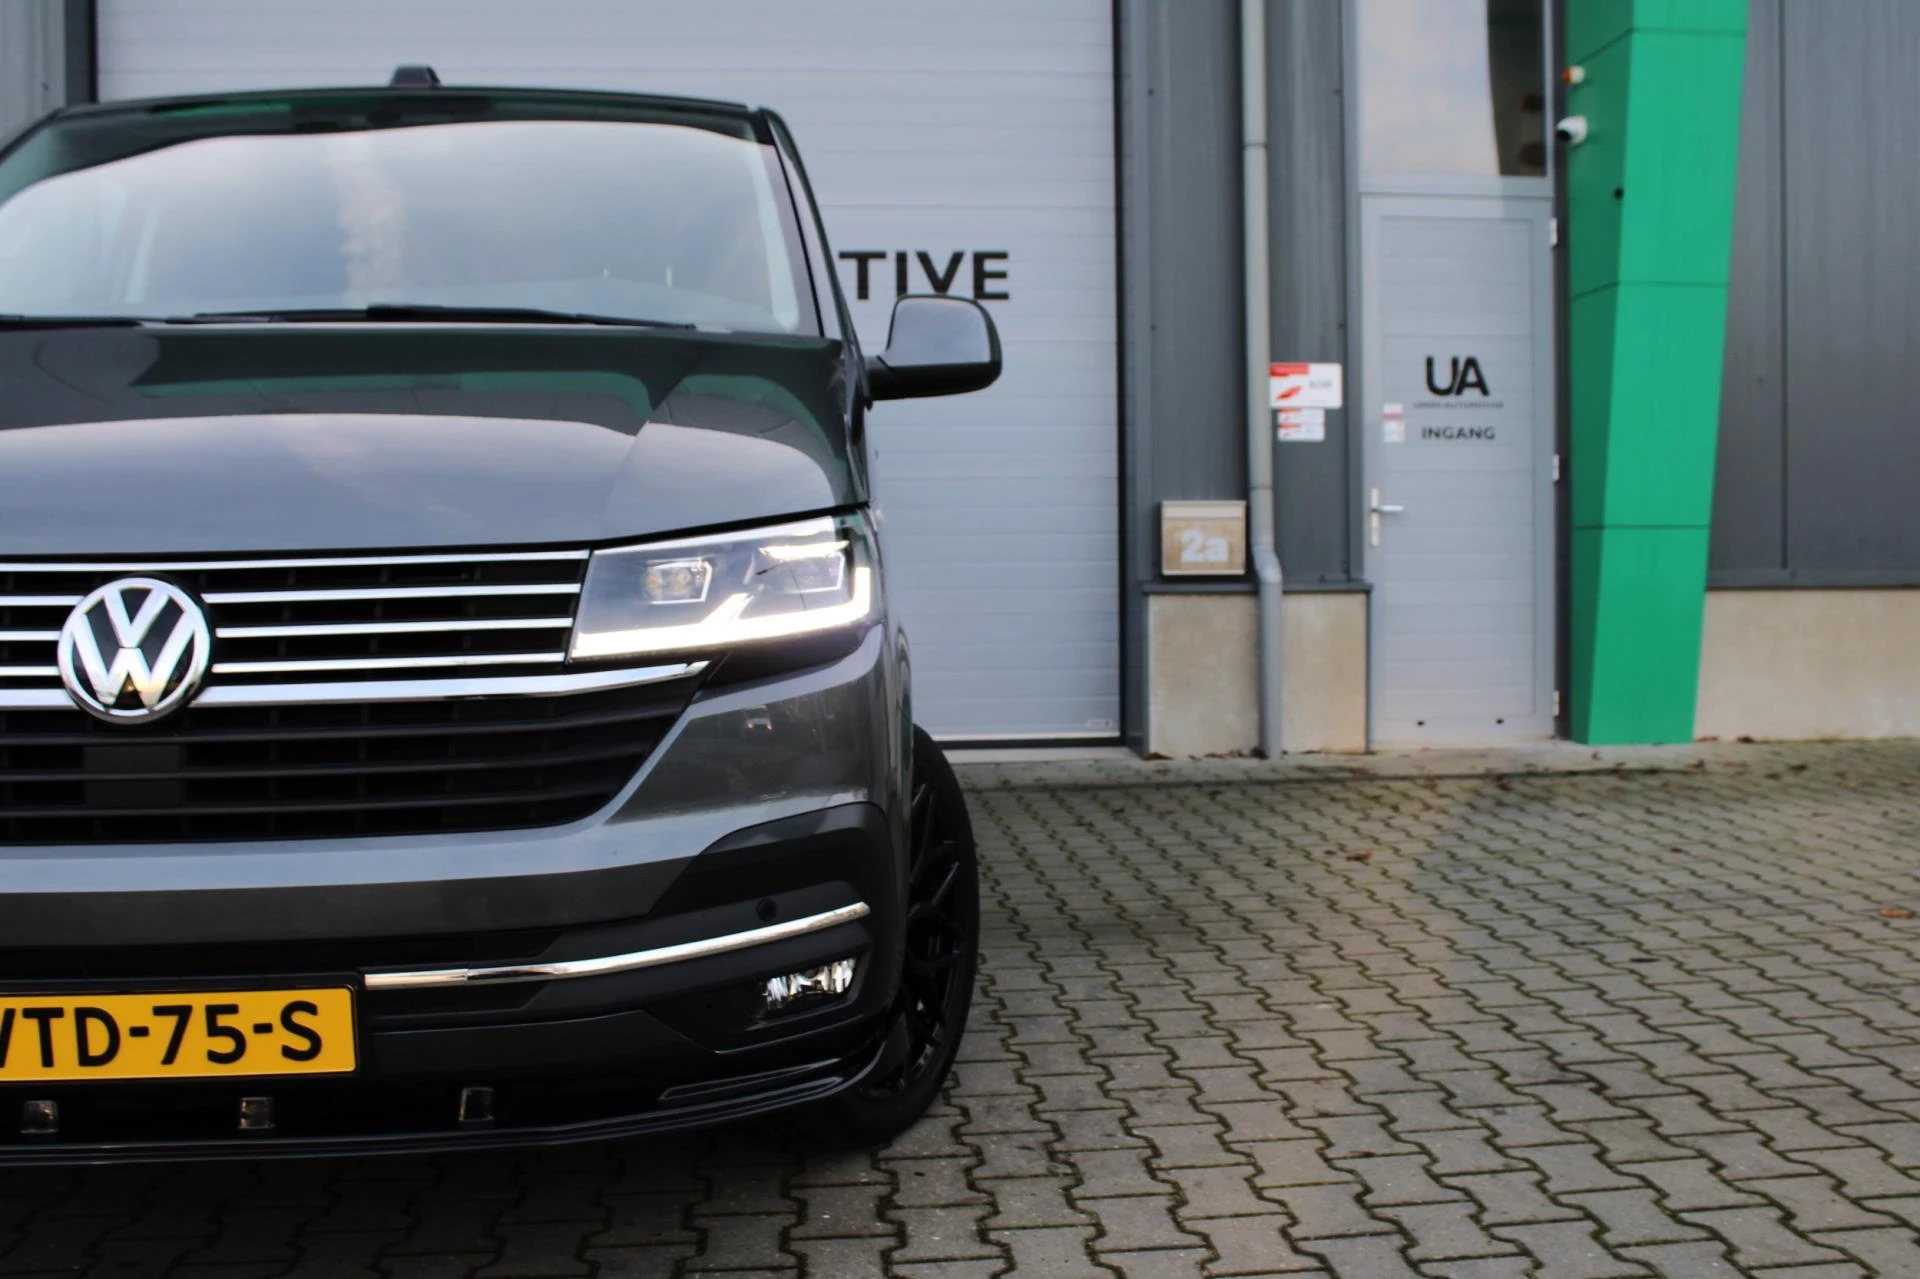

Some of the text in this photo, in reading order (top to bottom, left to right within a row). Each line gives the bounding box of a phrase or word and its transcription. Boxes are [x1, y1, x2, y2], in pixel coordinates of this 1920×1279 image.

[1425, 355, 1490, 397] UA
[1421, 425, 1496, 440] INGANG
[1179, 529, 1230, 562] 2a
